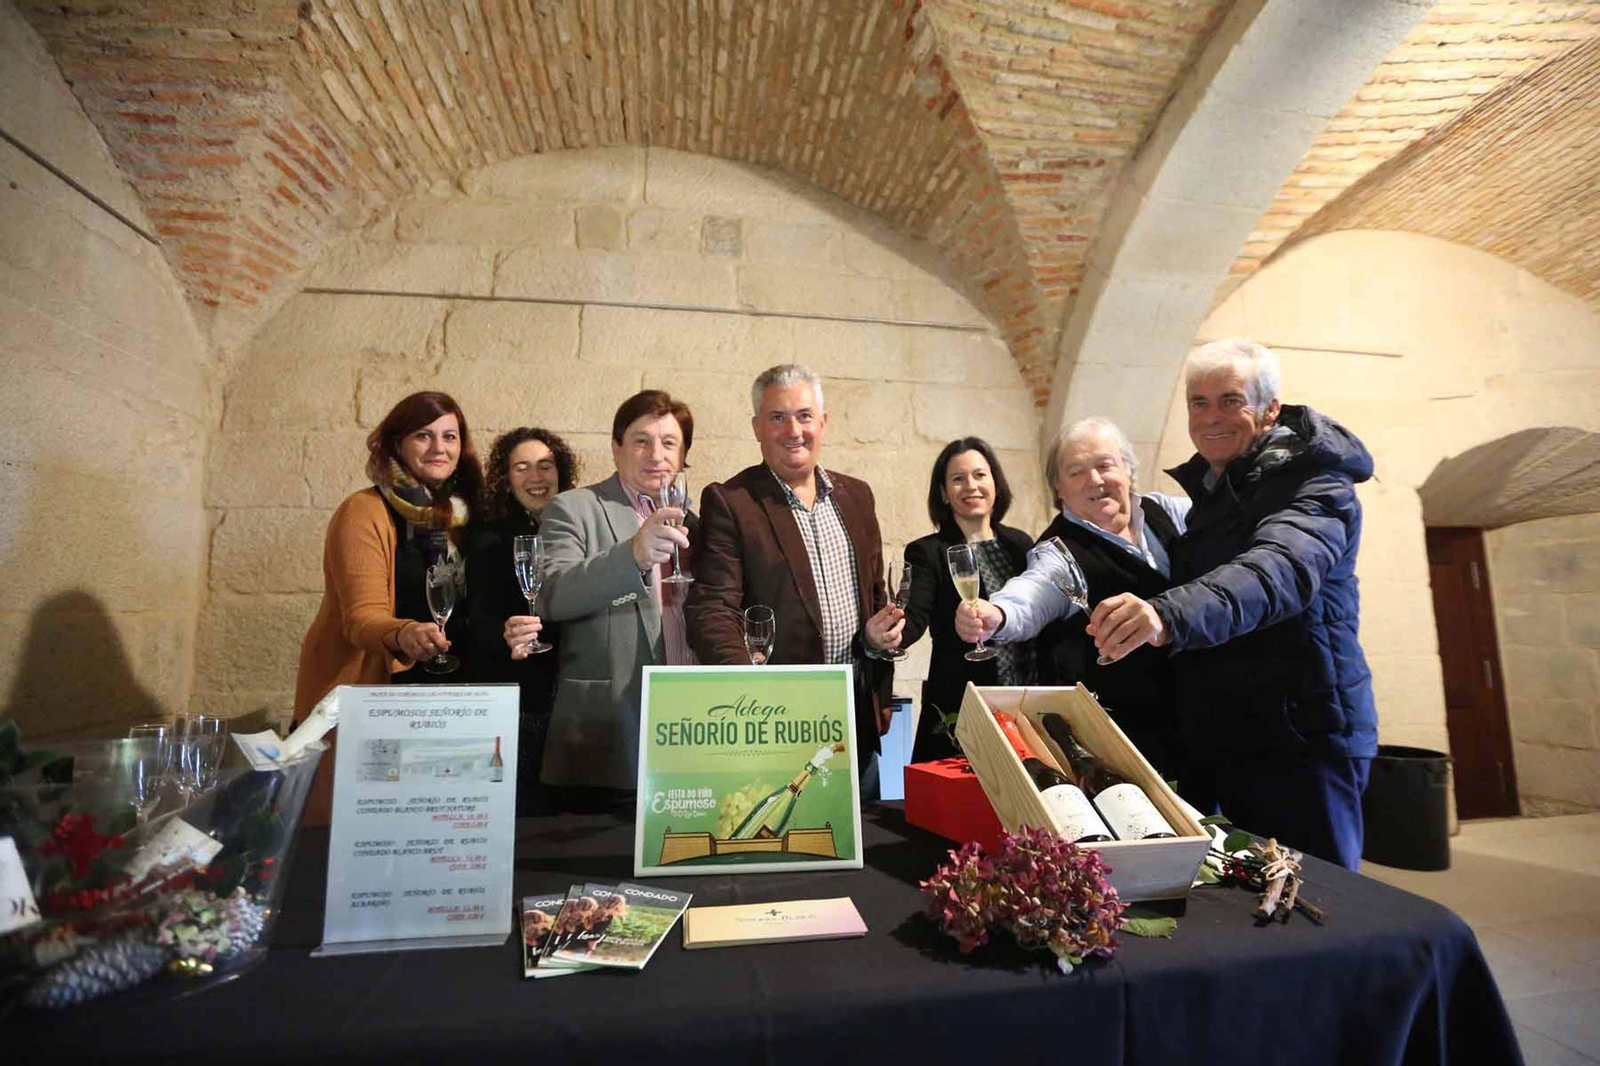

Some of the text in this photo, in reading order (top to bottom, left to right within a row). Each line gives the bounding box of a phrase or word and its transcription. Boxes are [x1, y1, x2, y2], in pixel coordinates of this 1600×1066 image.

[707, 694, 790, 722] Adega
[655, 714, 843, 746] SEÑORÍO DE RUBIÓS
[652, 791, 717, 814] Espumoso
[624, 888, 678, 902] CONDADO
